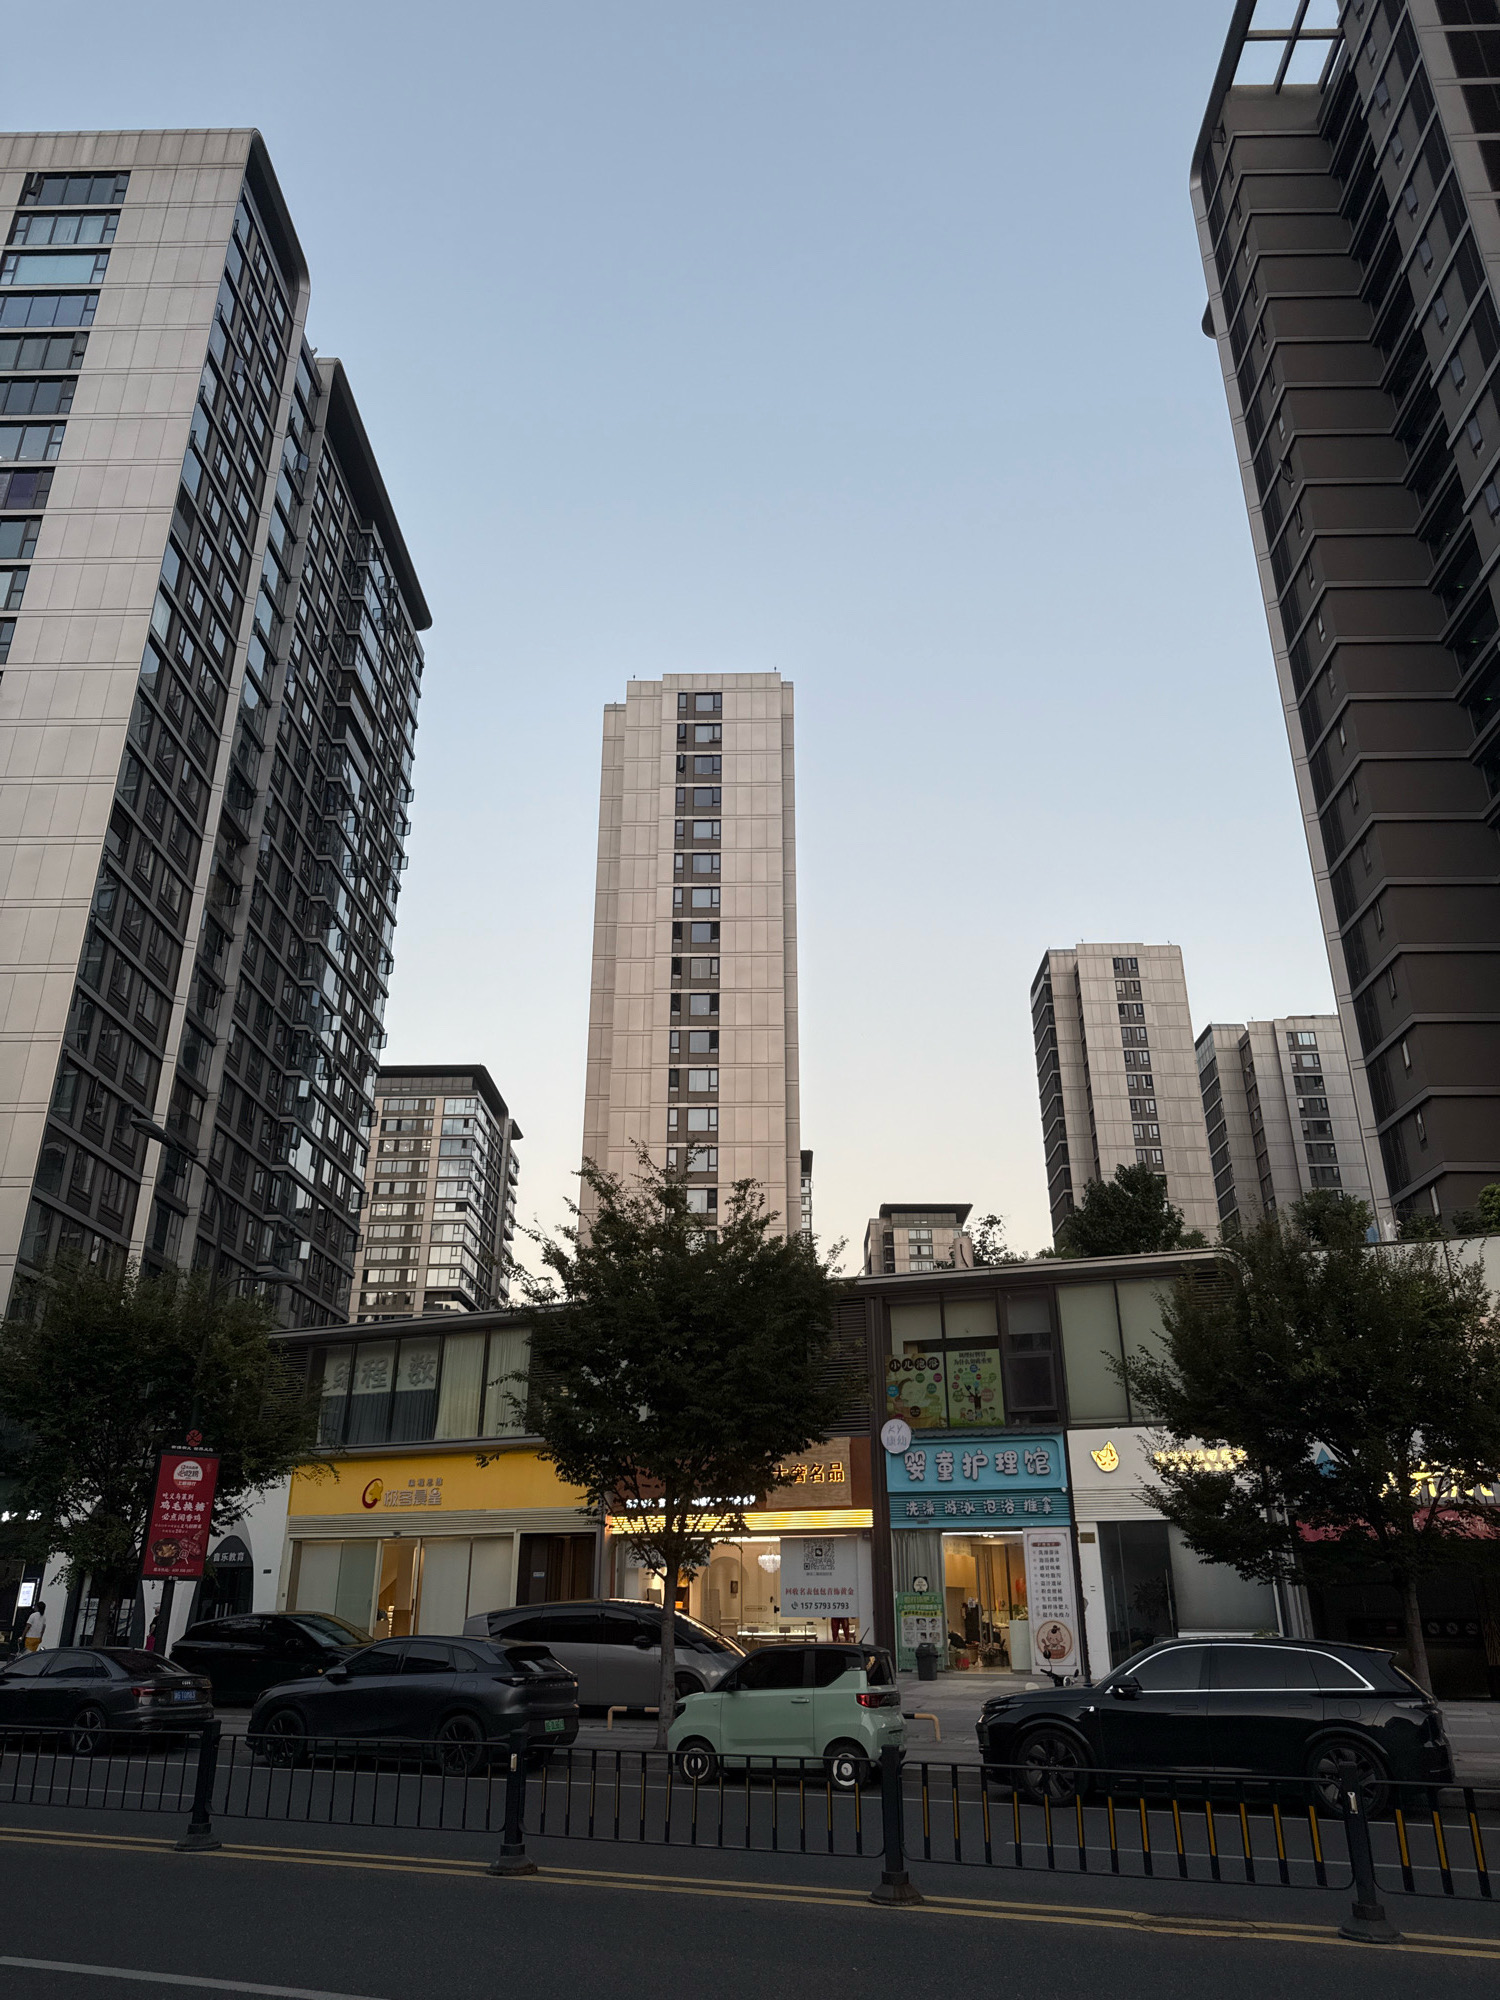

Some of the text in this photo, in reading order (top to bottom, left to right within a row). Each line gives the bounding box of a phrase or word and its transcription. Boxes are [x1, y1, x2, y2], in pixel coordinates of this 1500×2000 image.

[890, 1358, 940, 1370] 小儿泡浴
[888, 1424, 903, 1435] KY
[904, 1446, 1051, 1482] 婴童护理馆
[160, 1500, 206, 1512] 鸡毛换糖
[905, 1496, 1053, 1516] 洗澡 游泳 泡浴 推拿
[213, 1552, 245, 1562] 音乐教育
[785, 1587, 855, 1596] 回收名表包包首饰黄金
[800, 1602, 850, 1610] 157 5793 5793
